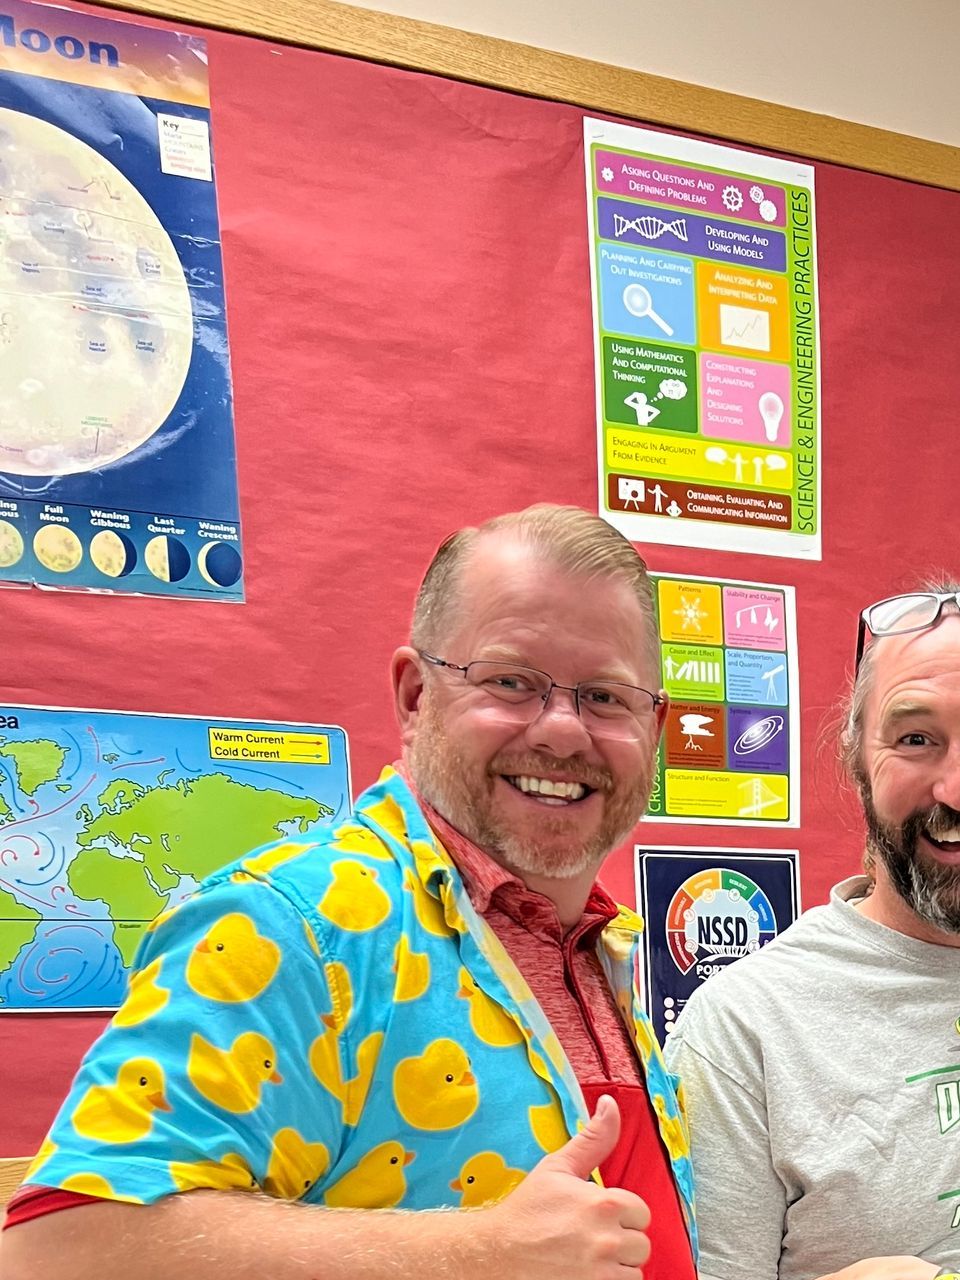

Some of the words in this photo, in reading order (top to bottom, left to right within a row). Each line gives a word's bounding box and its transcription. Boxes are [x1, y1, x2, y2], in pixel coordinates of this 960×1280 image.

[163, 120, 179, 131] Key
[792, 191, 811, 296] PRACTICES
[796, 303, 814, 430] ENGINEERING
[798, 437, 814, 448] &
[798, 453, 814, 531] SCIENCE
[45, 505, 63, 513] Full
[40, 512, 69, 523] Moon
[90, 510, 129, 522] Waning
[154, 517, 174, 526] Last
[90, 518, 131, 529] Gibbous
[198, 522, 236, 534] Waning
[147, 524, 185, 535] Quarter
[198, 530, 238, 541] Crescent
[678, 585, 701, 593] Patterns
[726, 590, 748, 599] Stability
[760, 594, 780, 602] Change
[669, 647, 686, 655] Cause
[213, 732, 243, 743] Warm
[245, 734, 285, 745] Current
[214, 747, 235, 757] Cold
[237, 748, 280, 759] Current
[697, 916, 748, 946] NSSD
